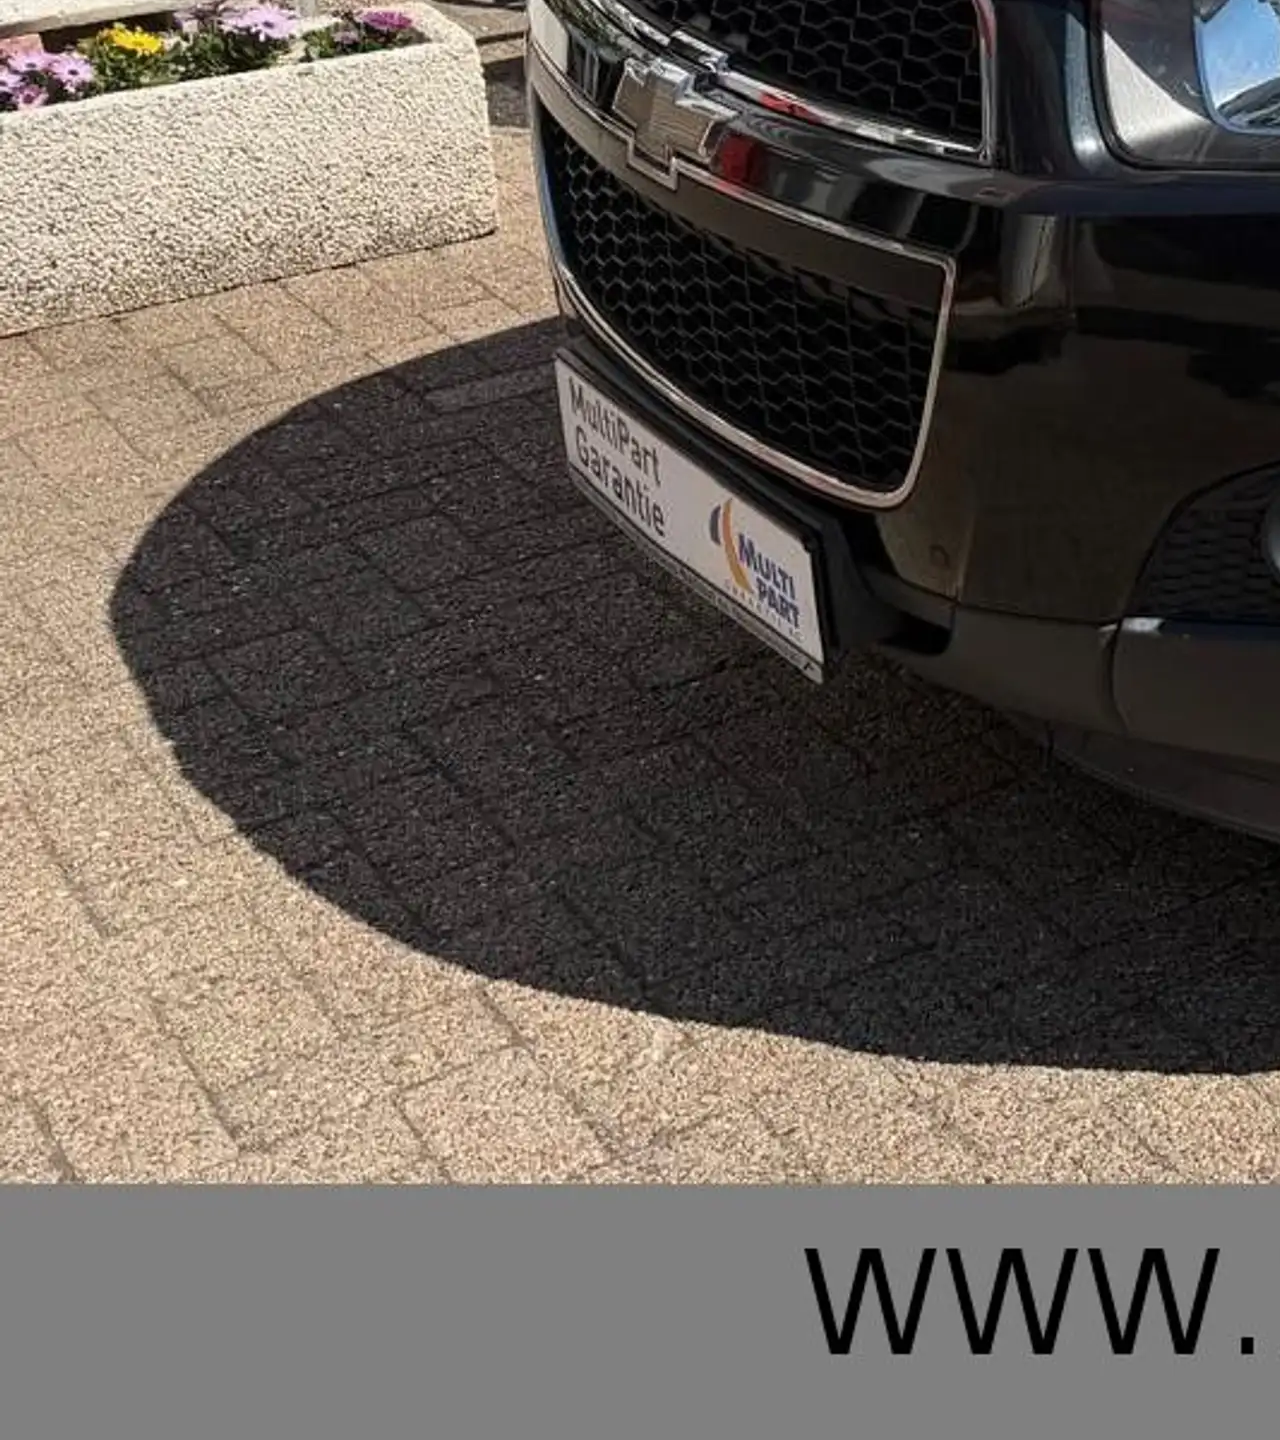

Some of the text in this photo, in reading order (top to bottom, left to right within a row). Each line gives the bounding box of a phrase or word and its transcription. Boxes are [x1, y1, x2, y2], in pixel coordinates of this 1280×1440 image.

[567, 375, 662, 488] MultiPart
[574, 424, 666, 537] Garantie
[738, 532, 795, 599] MULTI
[755, 576, 801, 630] PART
